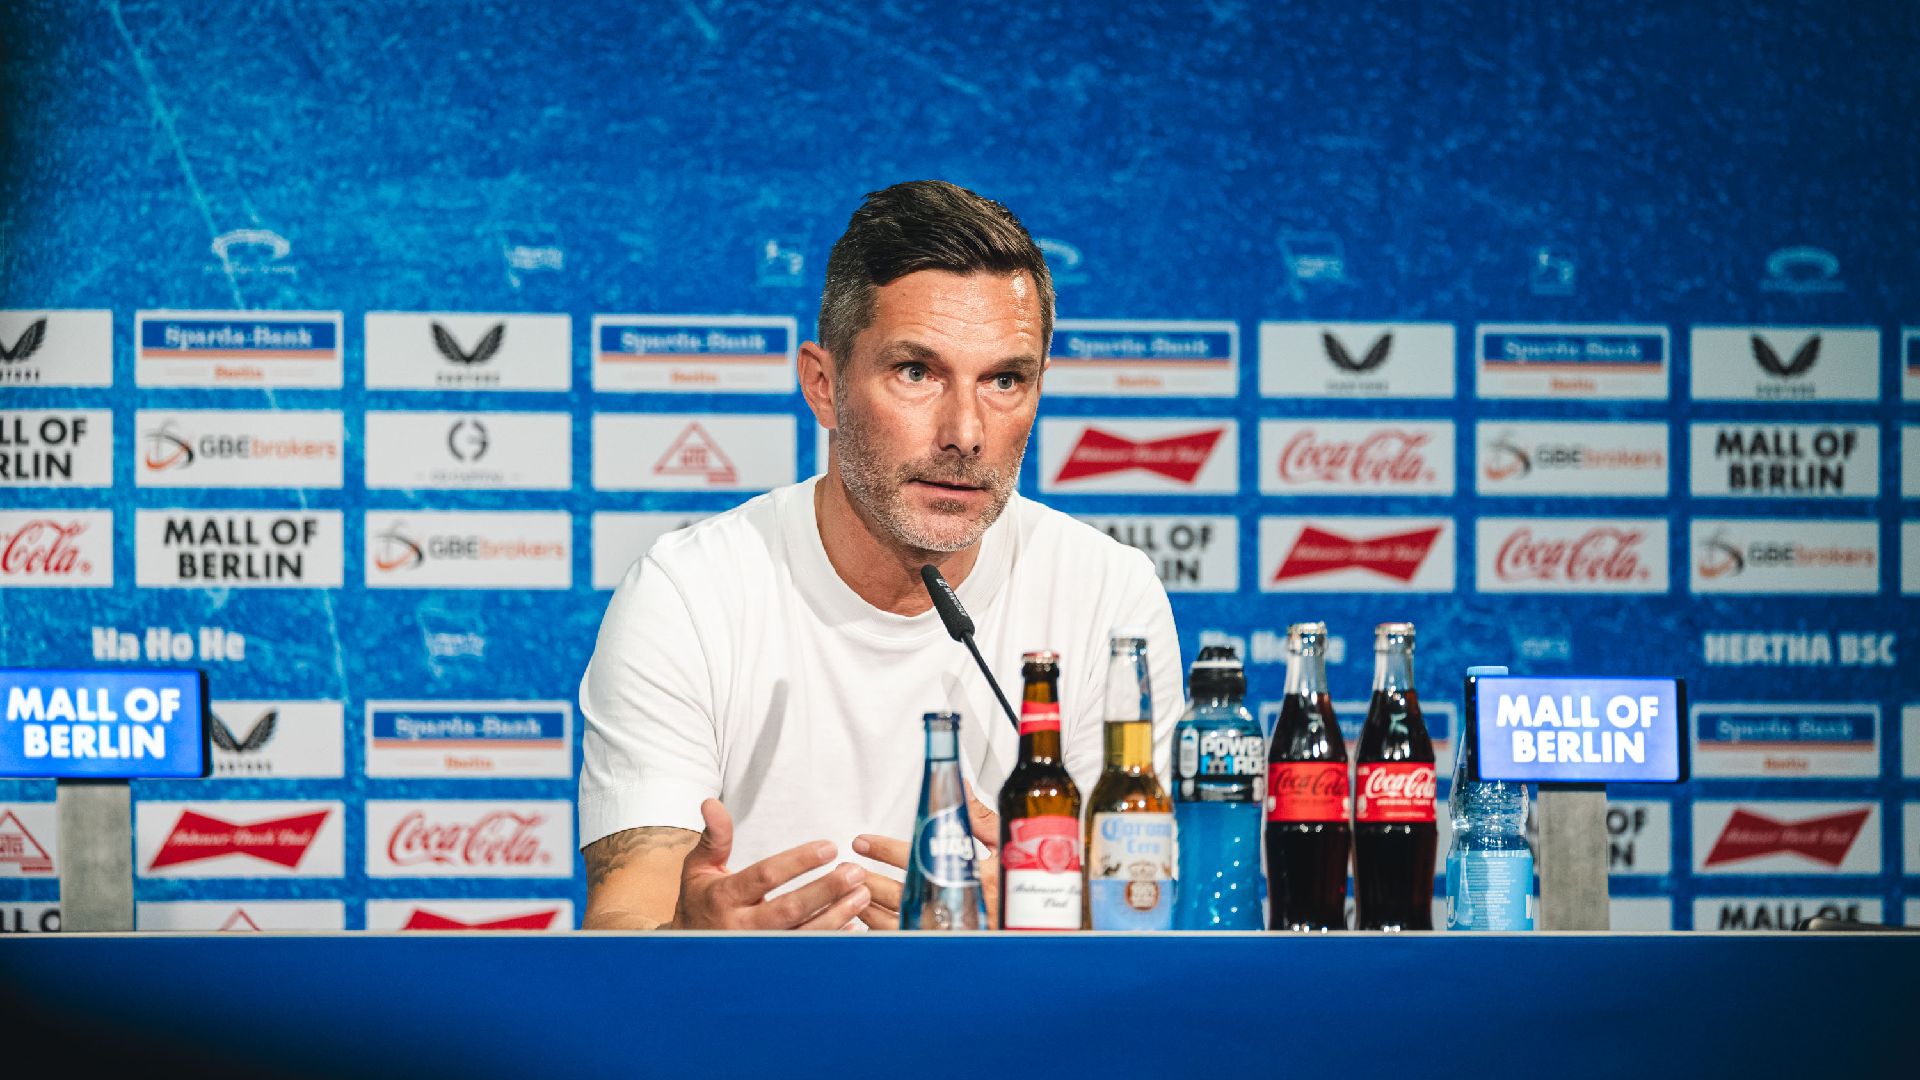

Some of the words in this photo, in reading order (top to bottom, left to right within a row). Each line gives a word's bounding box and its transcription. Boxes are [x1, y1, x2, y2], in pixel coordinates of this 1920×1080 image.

[0, 417, 29, 447] LL
[39, 417, 87, 446] OF
[1715, 430, 1802, 460] MALL
[1812, 430, 1859, 460] OF
[199, 435, 336, 460] GBEbrokers
[0, 451, 72, 479] RLIN
[1727, 463, 1844, 491] BERLIN
[163, 518, 259, 546] MALL
[270, 518, 318, 546] OF
[1168, 524, 1214, 552] OF
[428, 536, 567, 560] GBEbrokers
[177, 551, 303, 579] BERLIN
[91, 627, 140, 662] Ha
[144, 627, 195, 662] Ho
[198, 627, 246, 662] He
[1703, 632, 1831, 666] HERTHA
[1839, 632, 1896, 666] BSC
[6, 687, 117, 722] MALL
[123, 687, 180, 722] OF
[1496, 694, 1600, 729] MALL
[1606, 694, 1659, 729] OF
[23, 725, 166, 759] BERLIN
[1512, 730, 1645, 764] BERLIN
[1606, 808, 1647, 836] OF
[39, 908, 61, 931] O
[1718, 902, 1801, 930] MALL
